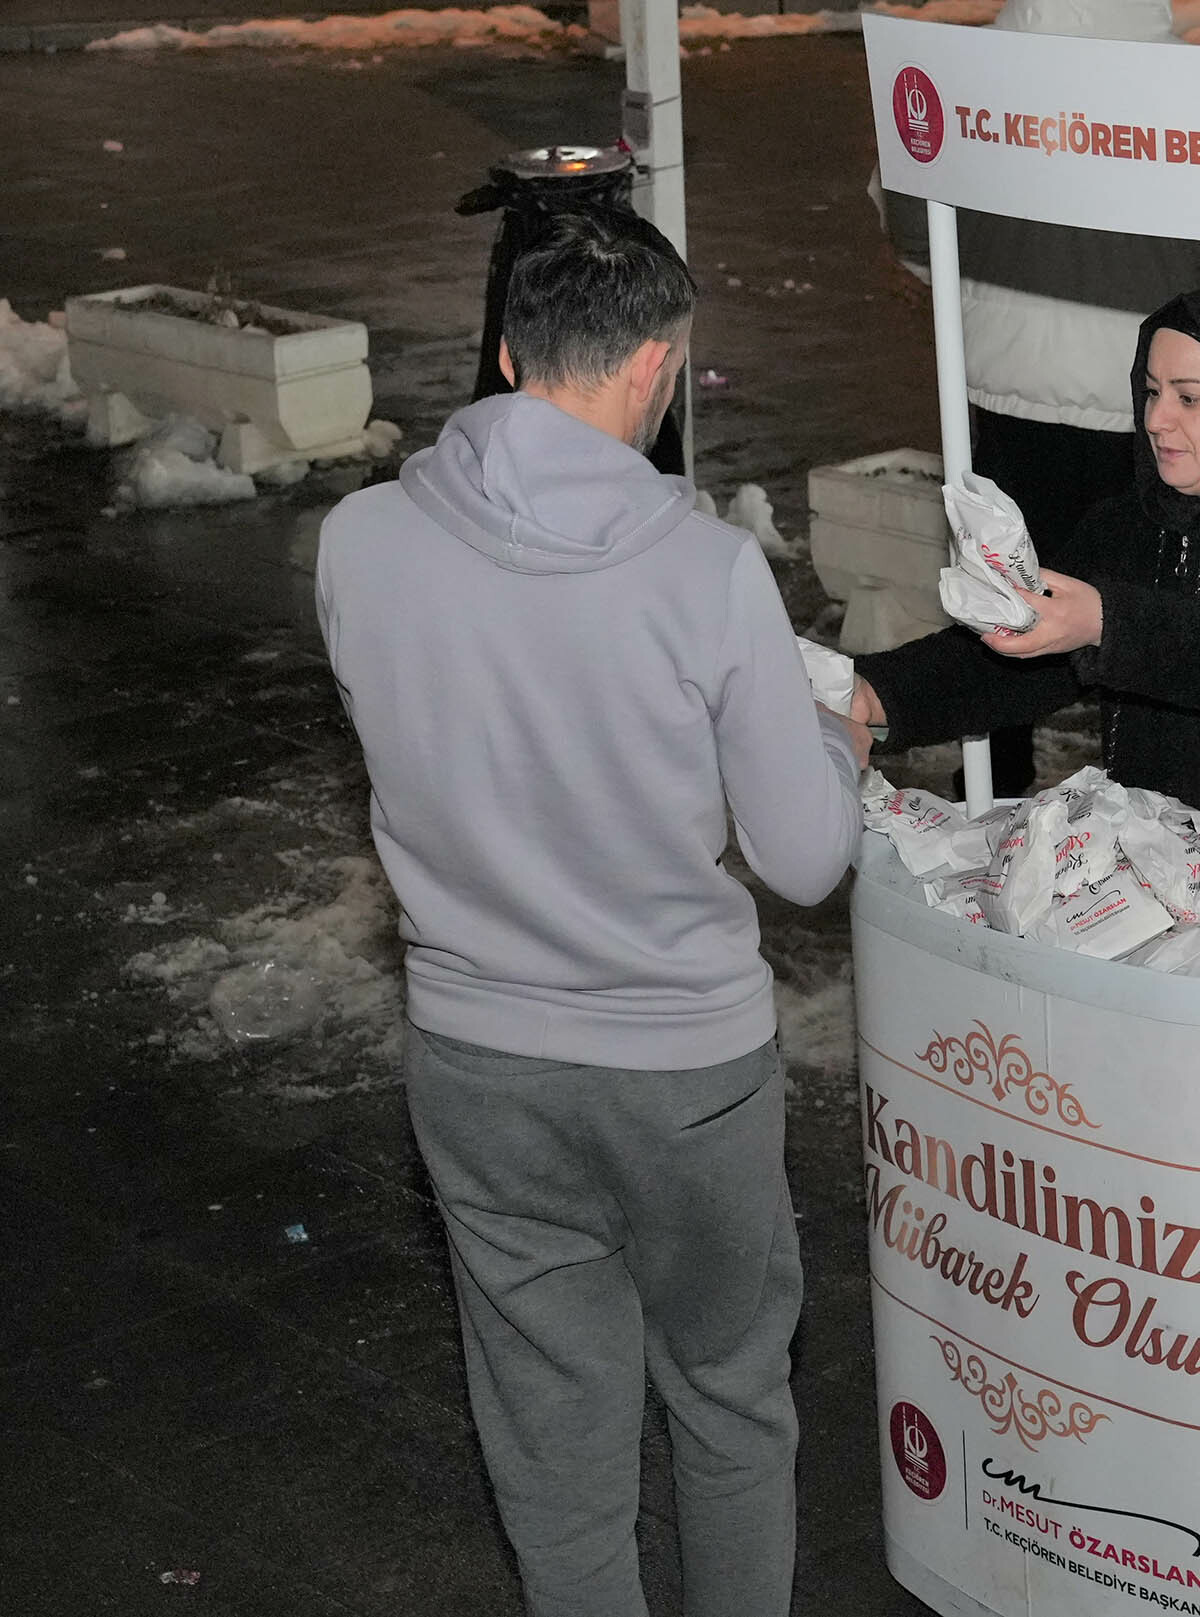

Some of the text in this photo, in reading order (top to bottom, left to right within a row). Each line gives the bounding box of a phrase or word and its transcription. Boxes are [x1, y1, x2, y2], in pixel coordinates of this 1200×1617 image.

[955, 106, 999, 143] T.C.
[1004, 112, 1157, 161] KEÇİÖREN
[865, 1163, 1040, 1318] Mübarek
[982, 1490, 1062, 1539] Dr.MESUT
[984, 1517, 1003, 1538] T.C.
[1005, 1530, 1066, 1569] KEÇİÖREN
[1068, 1560, 1137, 1597] BELEDİYE
